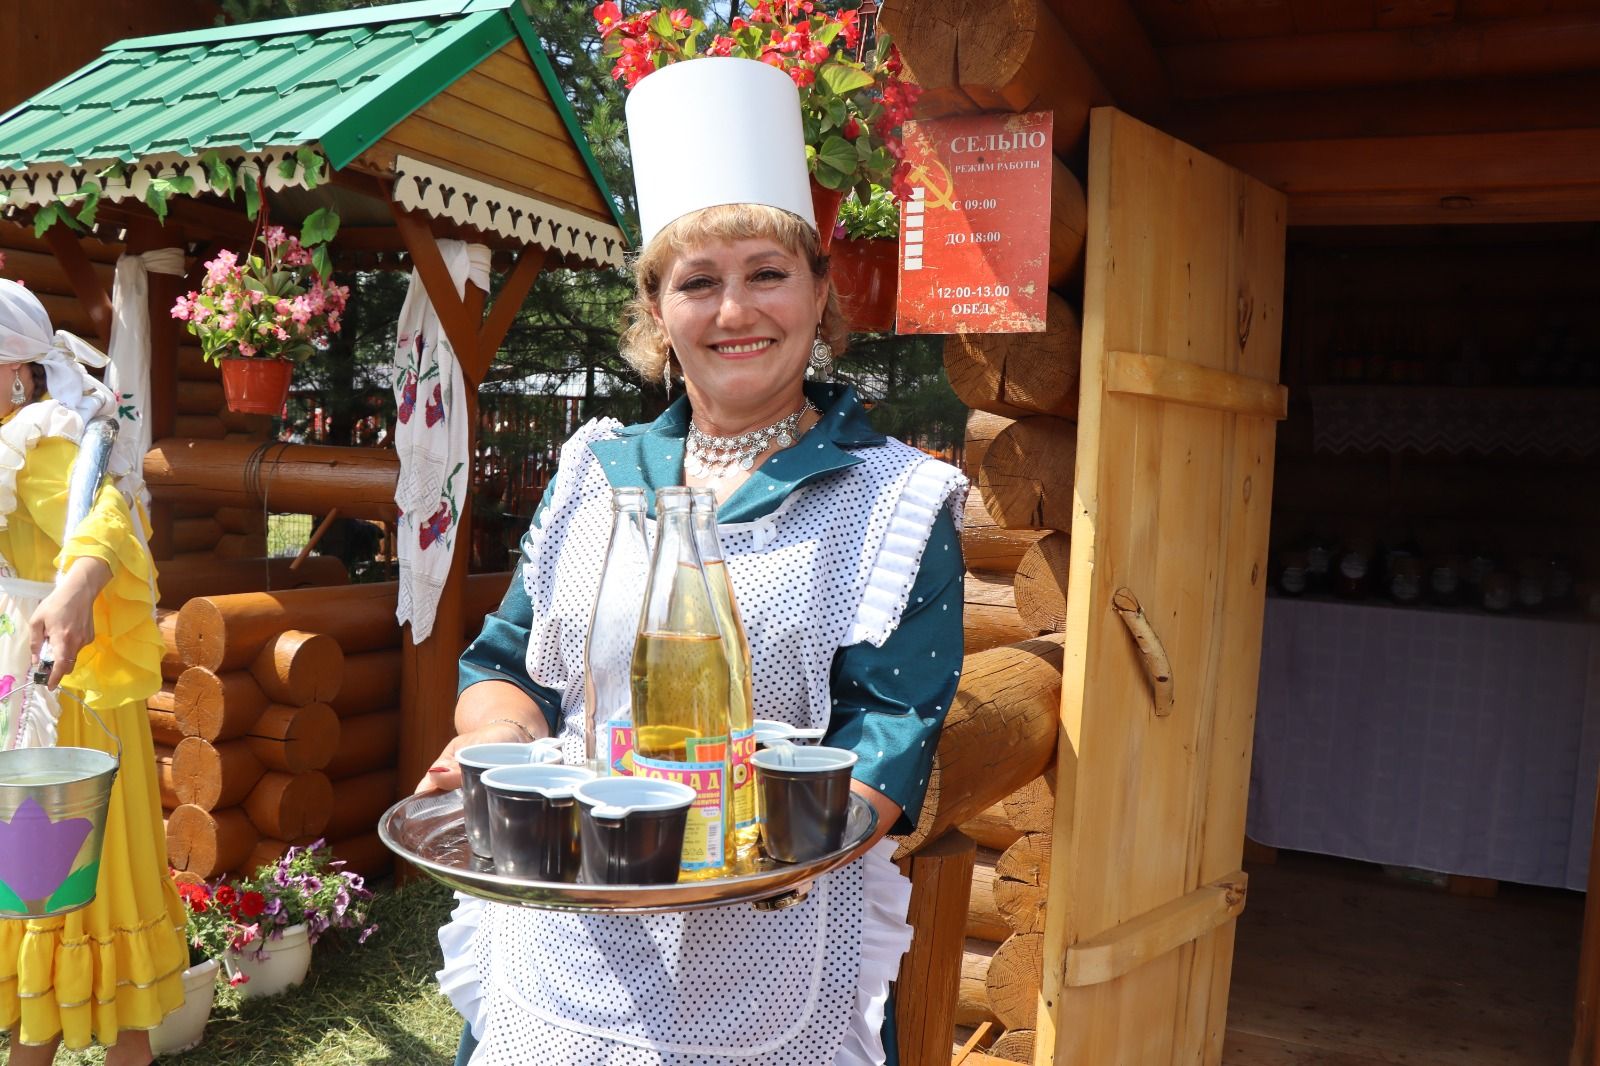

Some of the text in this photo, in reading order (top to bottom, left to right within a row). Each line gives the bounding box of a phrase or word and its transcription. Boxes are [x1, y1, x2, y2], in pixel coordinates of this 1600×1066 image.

[951, 131, 1046, 154] СЕЛЬПО
[955, 160, 1040, 174] РЕЖИМ РАБОТЫ
[952, 199, 997, 211] С 09:00
[945, 231, 1001, 246] ДО 18:00
[937, 286, 1010, 299] 12:00-13.00
[951, 303, 990, 315] ОБЕД
